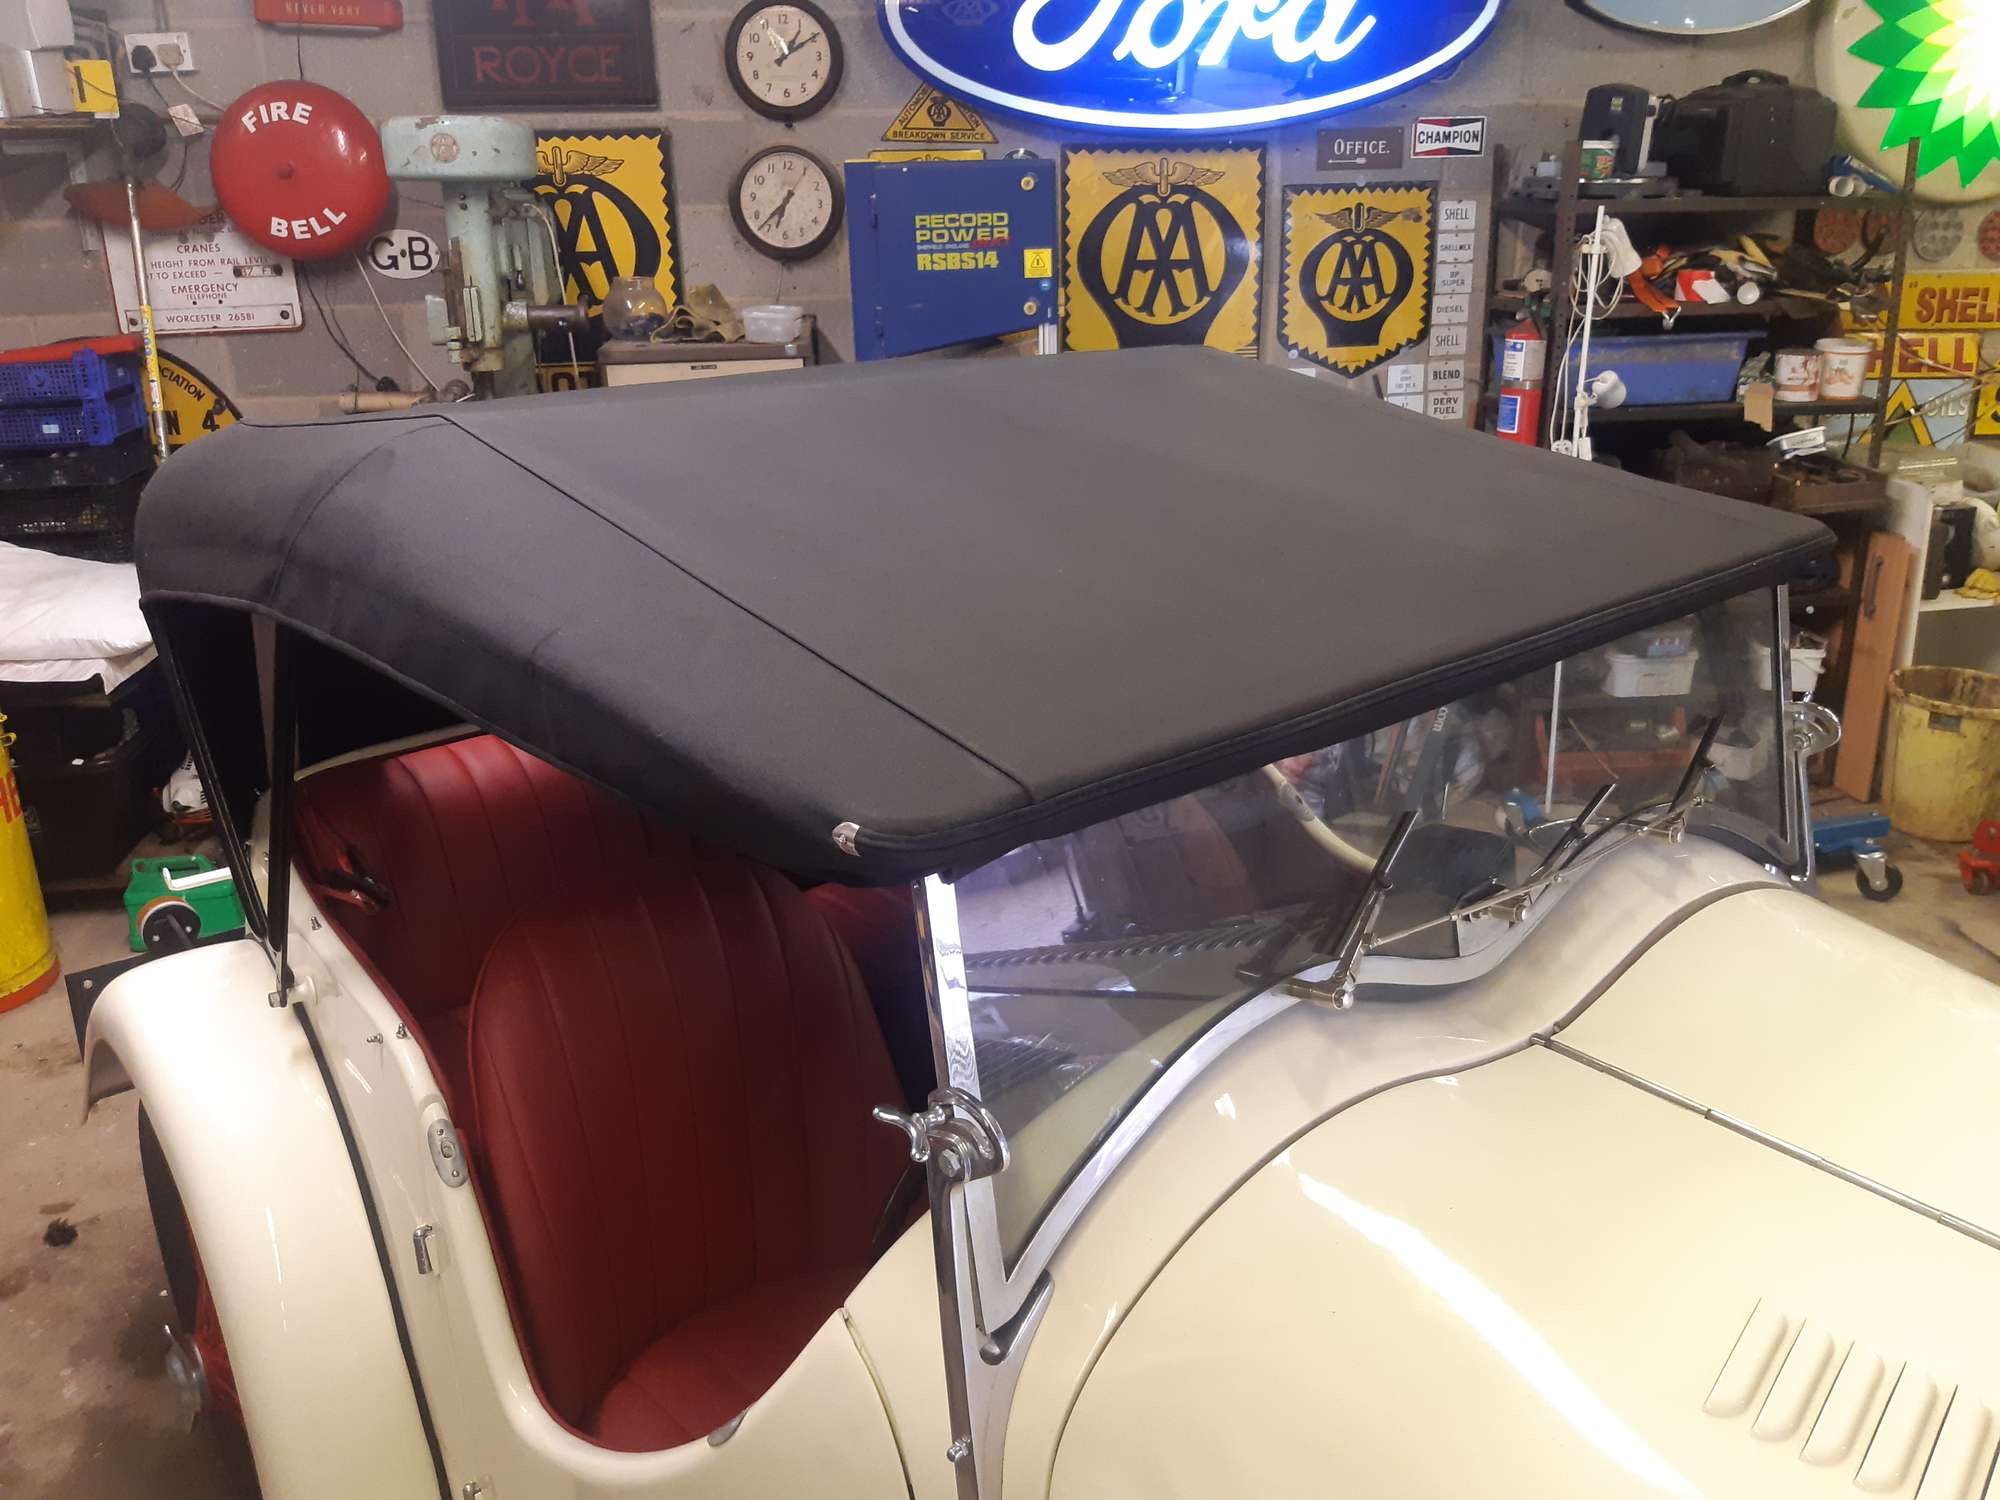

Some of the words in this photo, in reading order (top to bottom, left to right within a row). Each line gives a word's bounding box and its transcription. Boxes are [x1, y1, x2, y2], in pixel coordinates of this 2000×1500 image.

[778, 14, 788, 25] 12
[749, 33, 760, 43] 10
[746, 51, 754, 61] 9
[816, 51, 822, 61] 3
[473, 45, 624, 84] ROYCE
[753, 70, 759, 80] 8
[811, 70, 818, 79] 4
[766, 83, 772, 93] 7
[783, 88, 791, 98] 6
[800, 83, 807, 93] 5
[241, 101, 312, 134] FIRE
[892, 130, 946, 140] BREAKDOWN
[950, 131, 985, 140] SERVICE
[1418, 130, 1480, 144] CHAMPION
[767, 163, 774, 174] 11
[783, 160, 793, 171] 12
[754, 175, 765, 185] 10
[813, 181, 820, 191] 2
[750, 192, 757, 201] 9
[818, 199, 823, 209] 3
[754, 210, 760, 220] 8
[1444, 208, 1469, 220] SHELL
[270, 207, 347, 240] BELL
[811, 216, 818, 225] 4
[915, 212, 1008, 228] RECORD
[766, 223, 772, 232] 7
[799, 227, 804, 237] 5
[782, 231, 788, 240] 6
[915, 227, 1009, 243] POWER
[177, 243, 221, 254] CRANES
[151, 260, 184, 269] HEIGHT
[189, 258, 215, 267] FROM
[220, 257, 240, 265] RAIL
[917, 251, 999, 271] RSBS14
[157, 272, 169, 280] TO
[173, 270, 207, 279] EXCEED
[1441, 279, 1465, 287] SUPER
[171, 283, 239, 294] EMERGENCY
[186, 293, 228, 301] TELEPHONE
[1436, 305, 1464, 313] DIESEL
[166, 313, 221, 323] WORCESTER
[1435, 335, 1460, 347] SHELL
[1432, 370, 1460, 380] BLEND
[159, 365, 205, 402] CIATION
[1433, 397, 1459, 405] DERV
[1433, 406, 1457, 415] FUEL
[202, 409, 220, 432] 4
